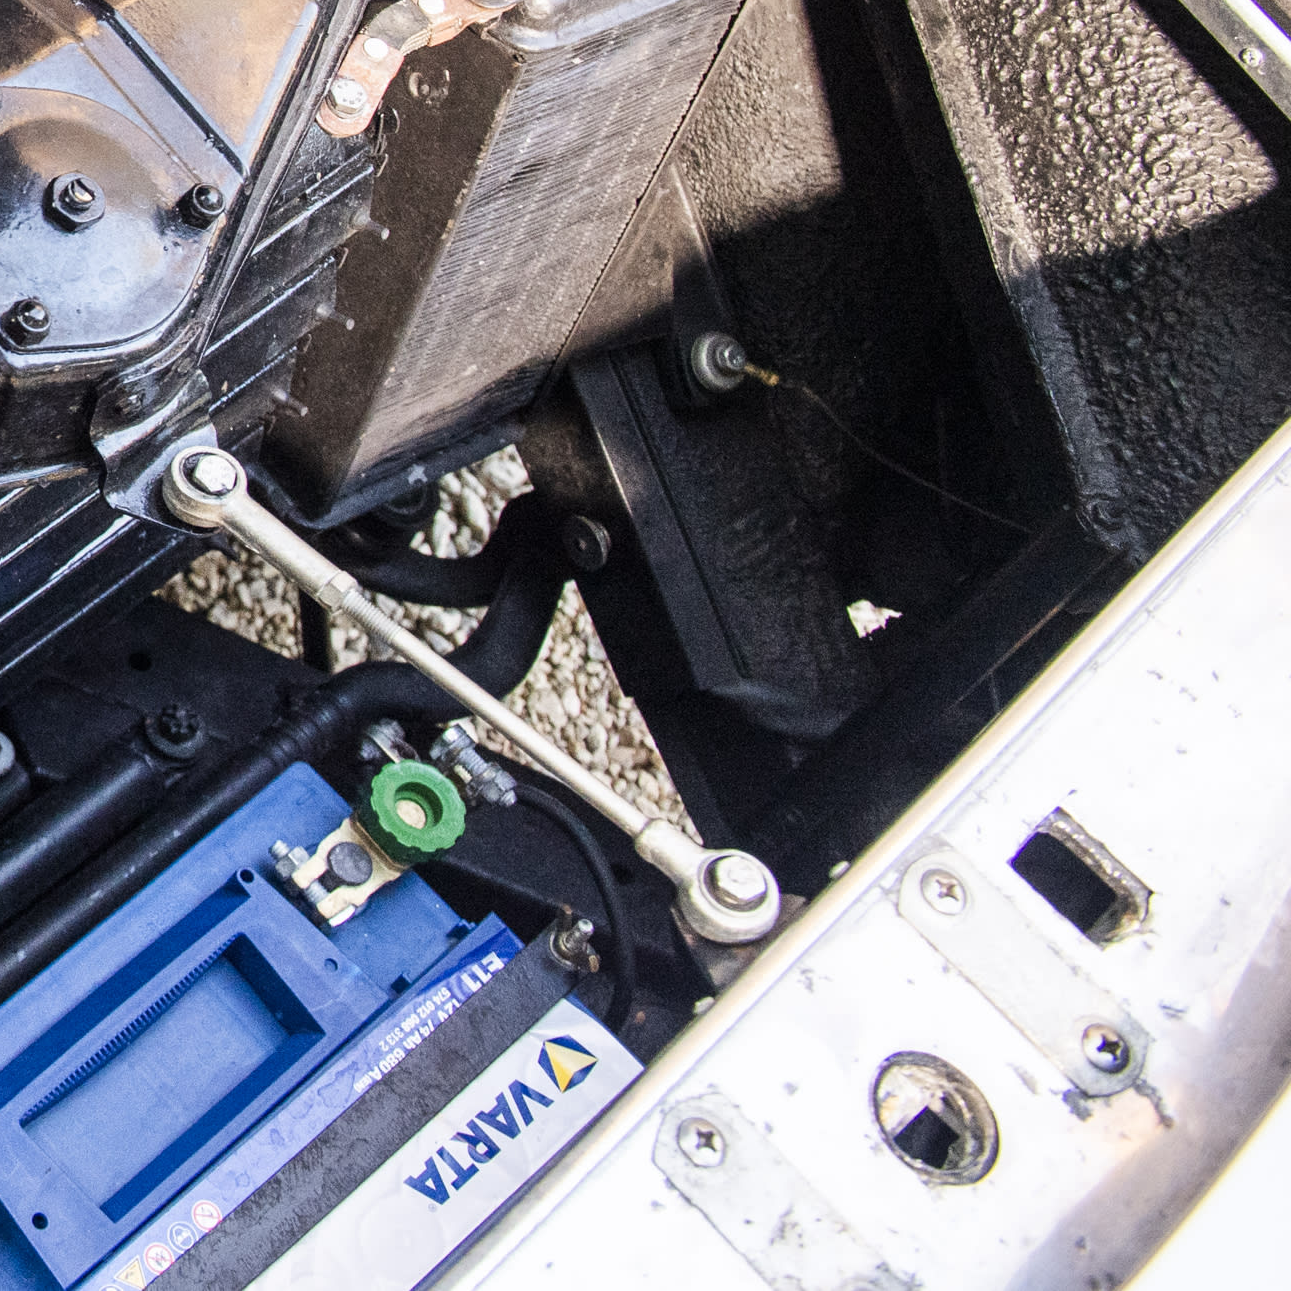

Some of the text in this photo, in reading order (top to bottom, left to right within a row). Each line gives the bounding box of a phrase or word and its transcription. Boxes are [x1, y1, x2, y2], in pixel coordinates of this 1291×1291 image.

[434, 986, 451, 1006] 574
[416, 1000, 436, 1019] 012
[386, 1026, 404, 1045] 313
[404, 1079, 554, 1205] VARTA
